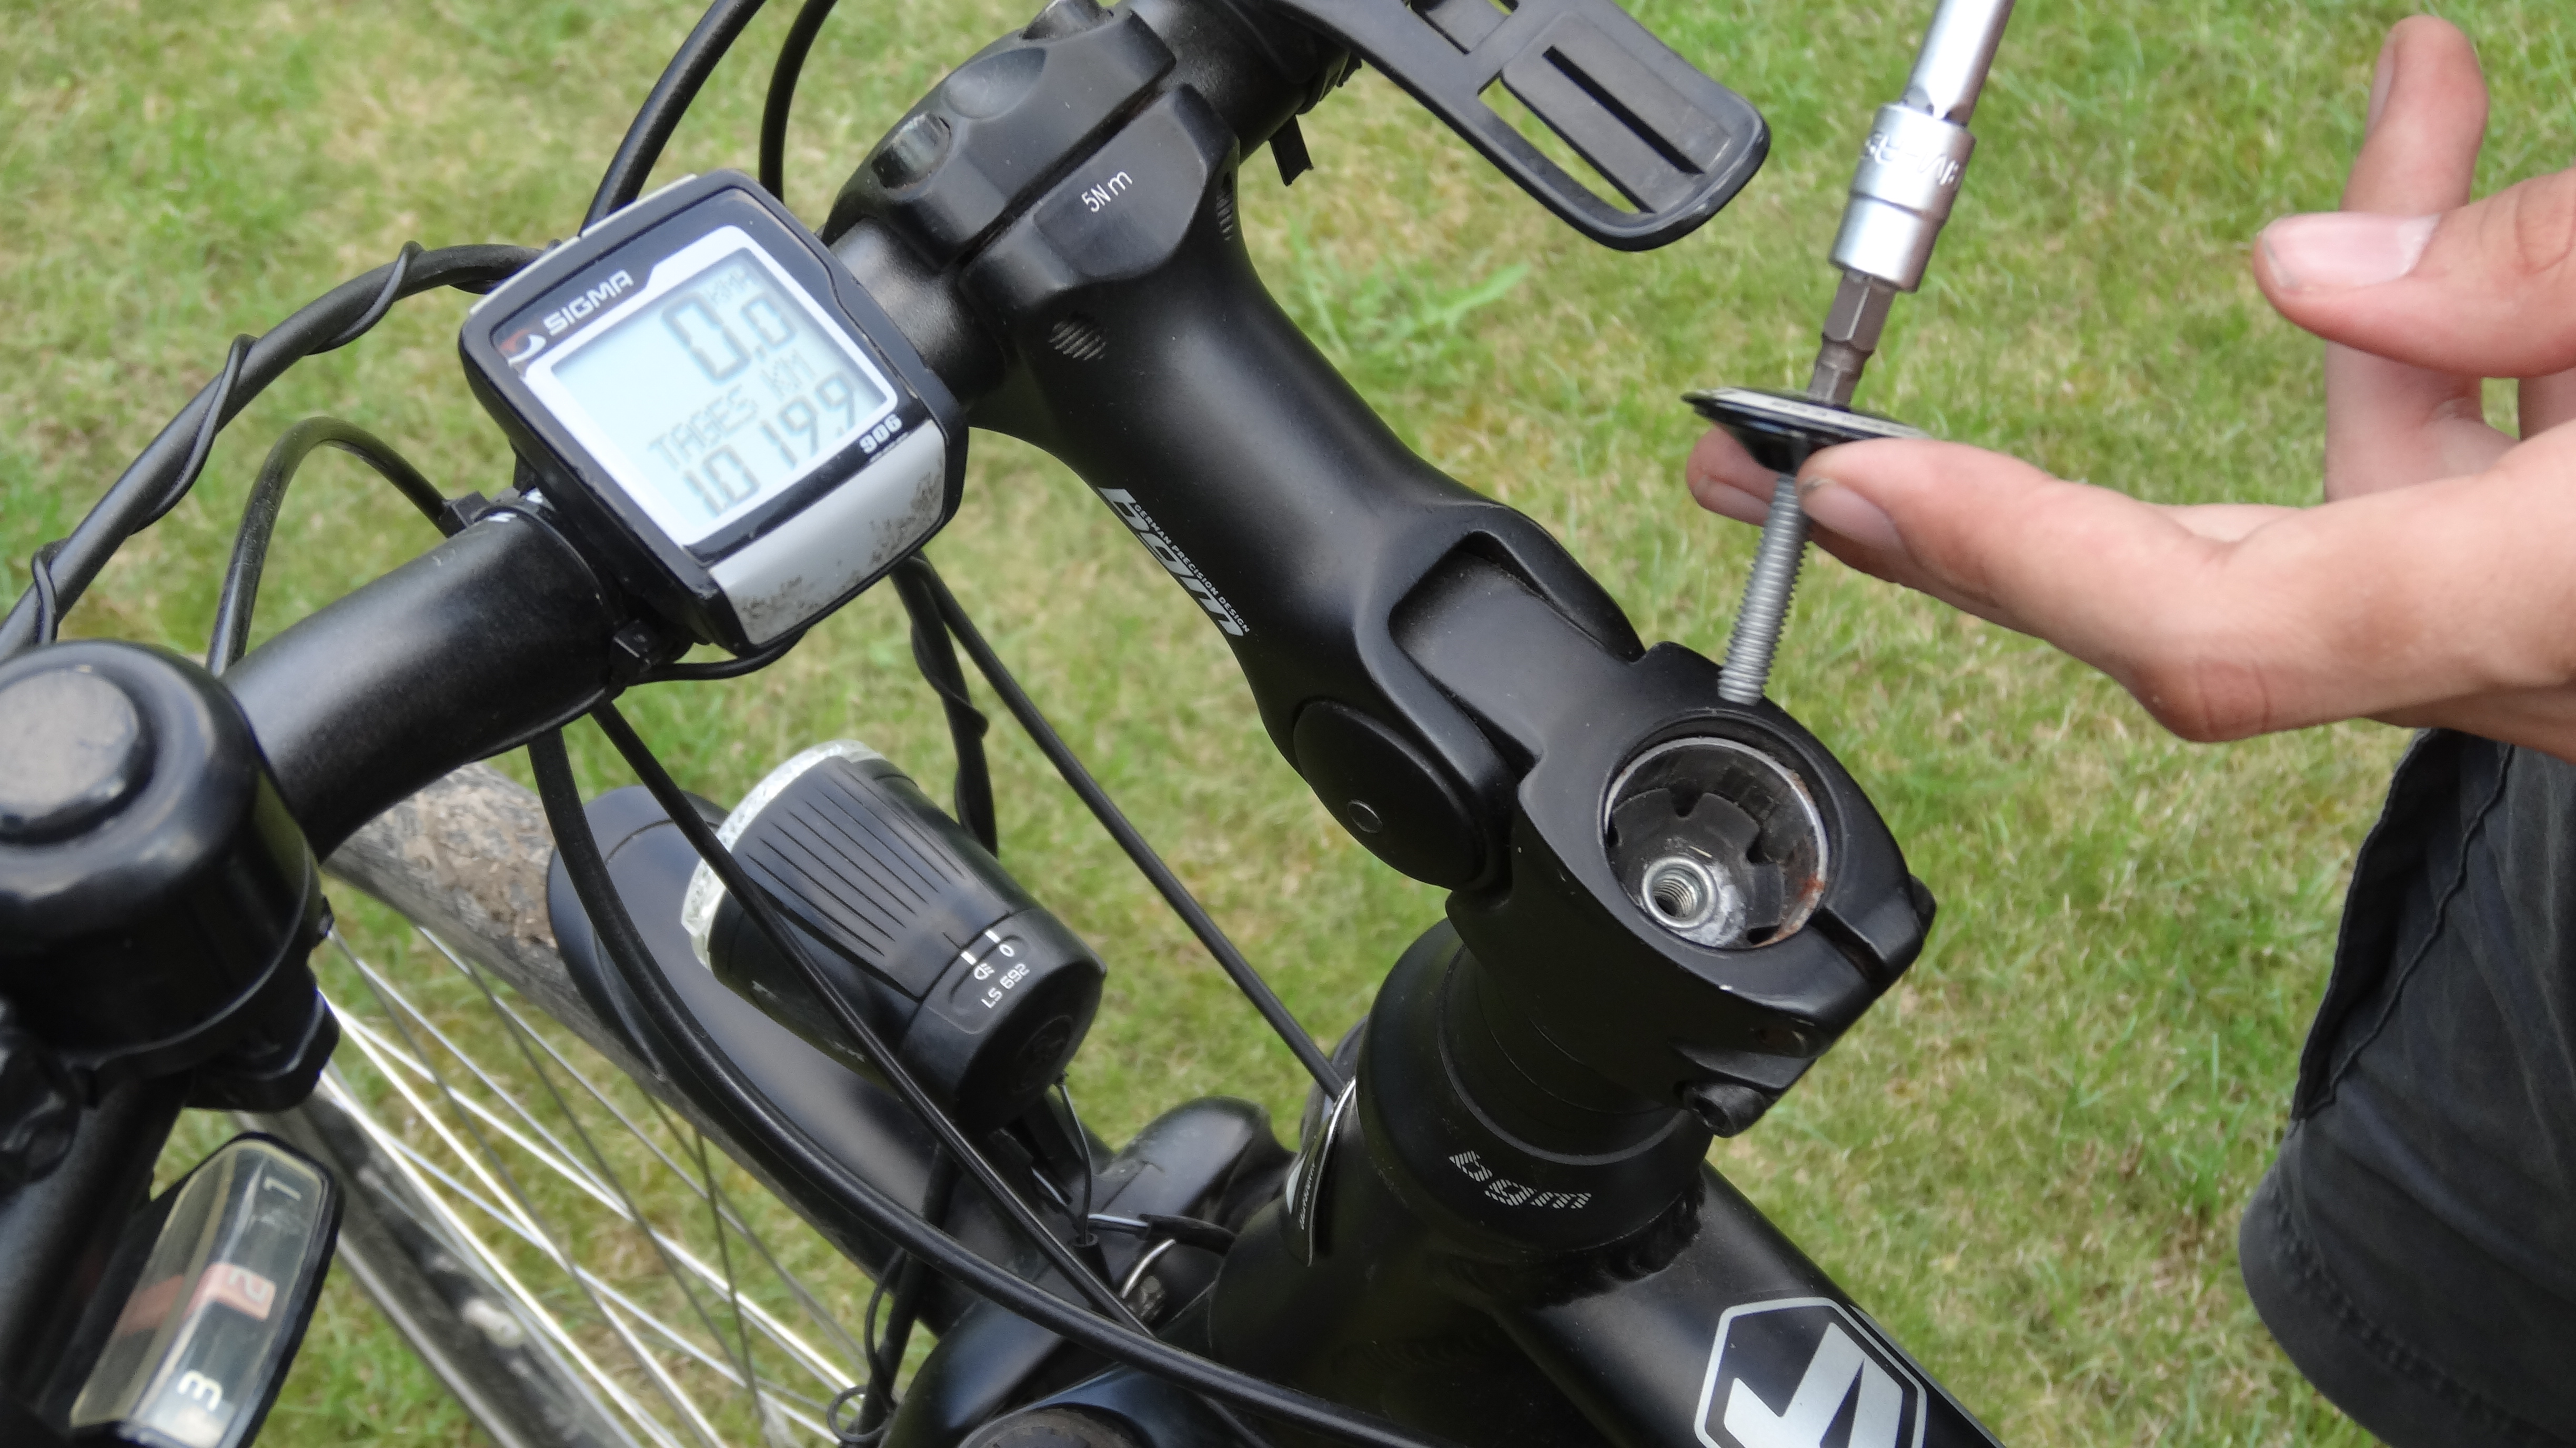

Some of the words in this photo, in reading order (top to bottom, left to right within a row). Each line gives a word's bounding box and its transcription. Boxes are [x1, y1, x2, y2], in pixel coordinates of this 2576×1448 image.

[544, 269, 633, 335] SIGMA
[859, 414, 902, 455] 906
[1134, 504, 1172, 545] GERMAN
[1171, 545, 1219, 595] PRECISION
[1218, 596, 1250, 633] DESIGN
[981, 988, 1003, 1009] LS
[1000, 963, 1030, 990] 692
[177, 1370, 223, 1411] 3
